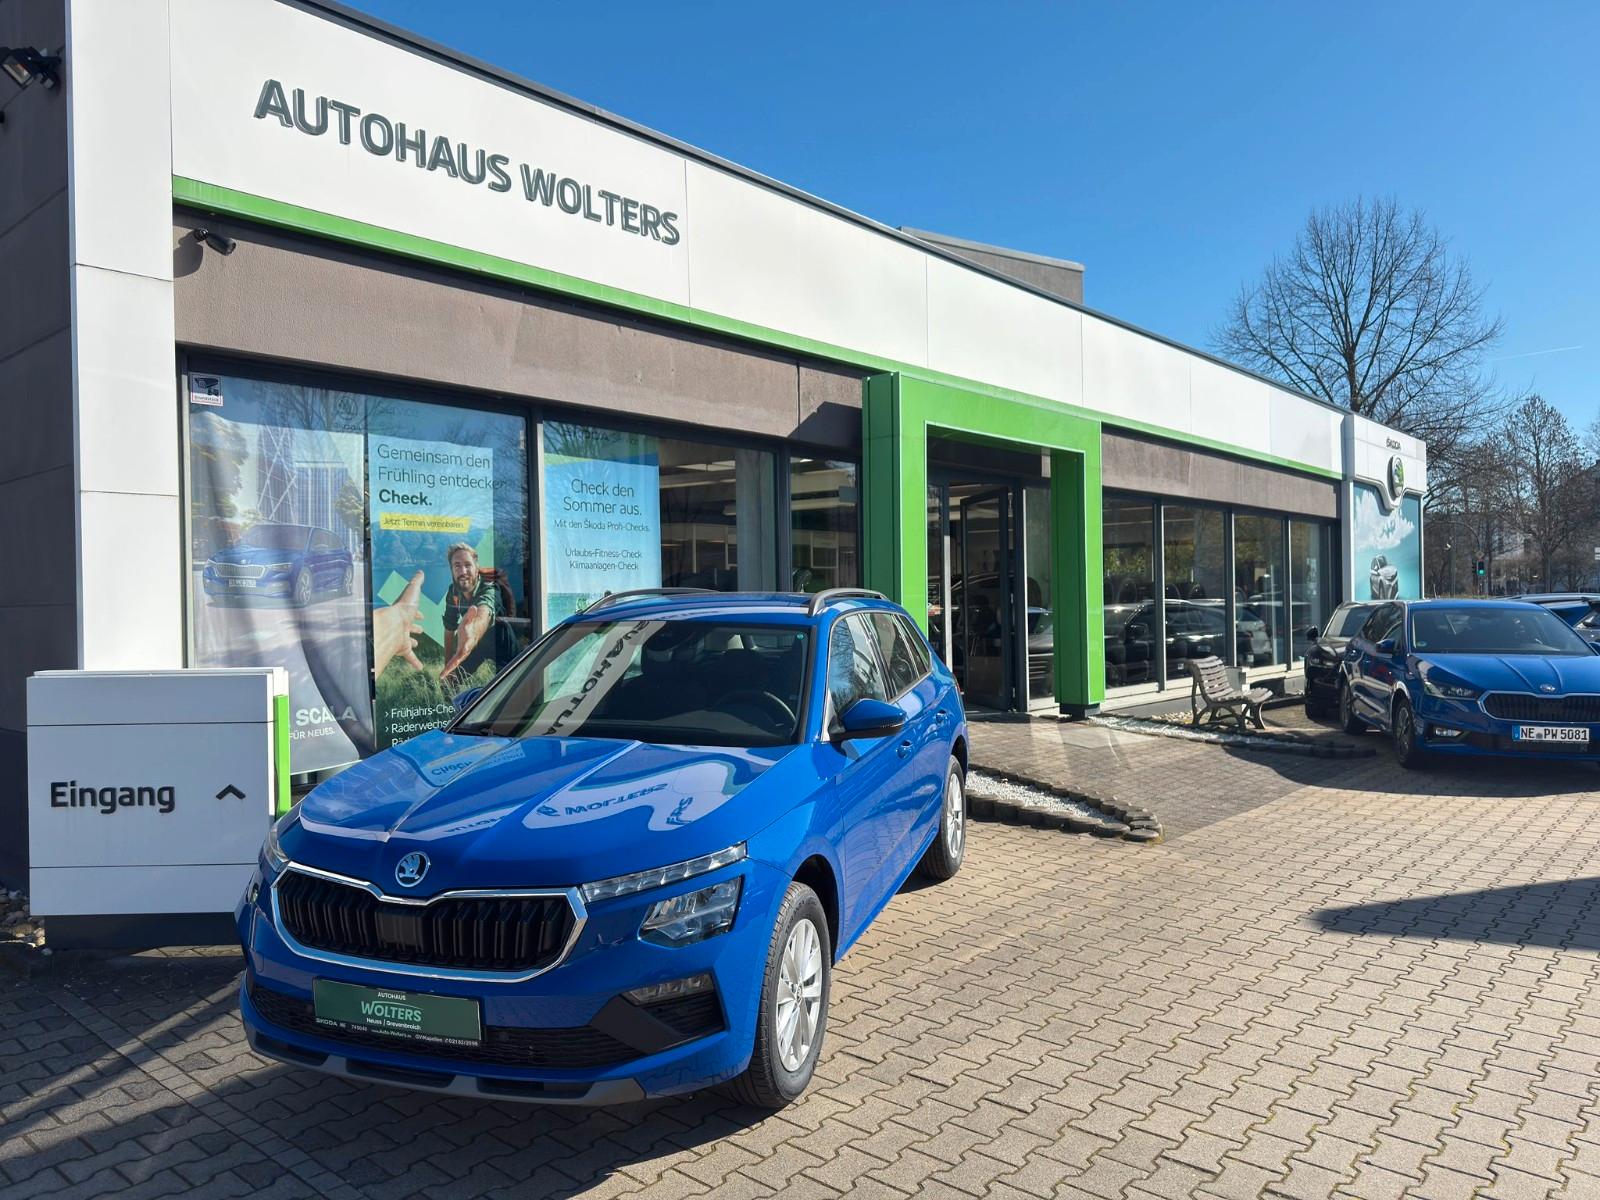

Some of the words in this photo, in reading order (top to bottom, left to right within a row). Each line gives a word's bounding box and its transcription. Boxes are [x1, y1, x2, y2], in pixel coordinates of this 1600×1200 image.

[253, 78, 512, 193] AUTOHAUS
[519, 163, 681, 246] WOLTERS
[377, 443, 463, 466] Gemeinsam
[465, 454, 490, 469] den
[378, 466, 435, 488] Frühling
[379, 488, 433, 507] Check.
[571, 478, 609, 496] Check
[612, 483, 634, 498] den
[563, 496, 616, 514] Sommer
[620, 504, 642, 516] aus.
[402, 518, 426, 528] Termin
[554, 519, 567, 529] Mit
[568, 520, 582, 529] den
[584, 518, 606, 530] Škoda
[295, 706, 358, 727] SCALA
[391, 704, 455, 722] Frühjahrs-Che
[391, 718, 450, 734] Räderwechs
[1521, 728, 1535, 738] NE
[1544, 728, 1558, 739] PW
[1560, 729, 1588, 740] 5081
[50, 780, 176, 815] Eingang
[377, 992, 406, 1001] AUTOHAUS
[361, 1001, 422, 1022] WOLTERS
